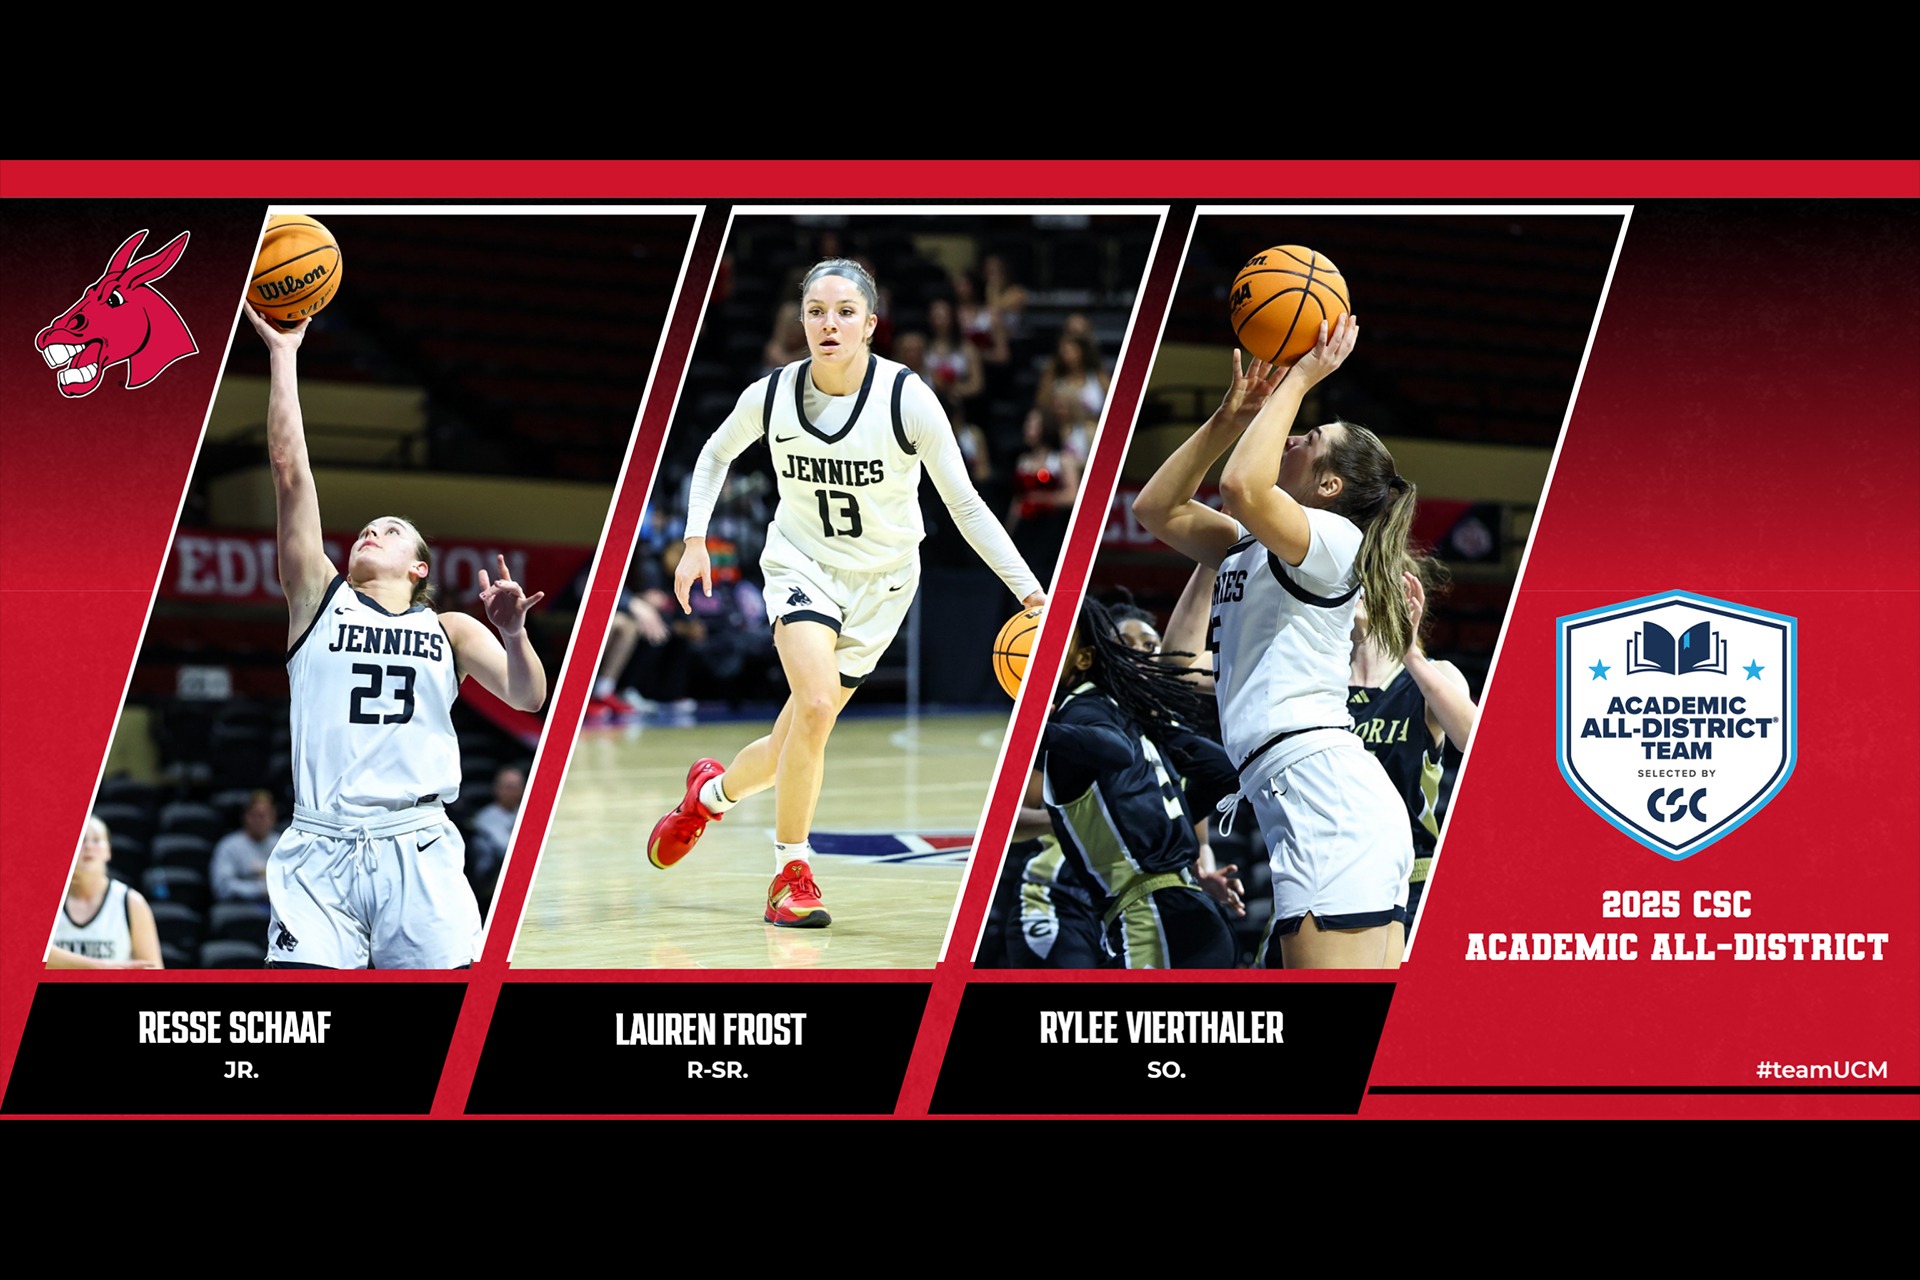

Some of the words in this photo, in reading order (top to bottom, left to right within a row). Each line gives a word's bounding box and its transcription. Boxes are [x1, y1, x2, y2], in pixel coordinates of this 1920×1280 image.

[257, 264, 327, 301] Wilson
[782, 454, 884, 487] JENNIES
[814, 489, 863, 538] 13
[328, 623, 444, 662] JENNIES
[349, 663, 416, 725] 23
